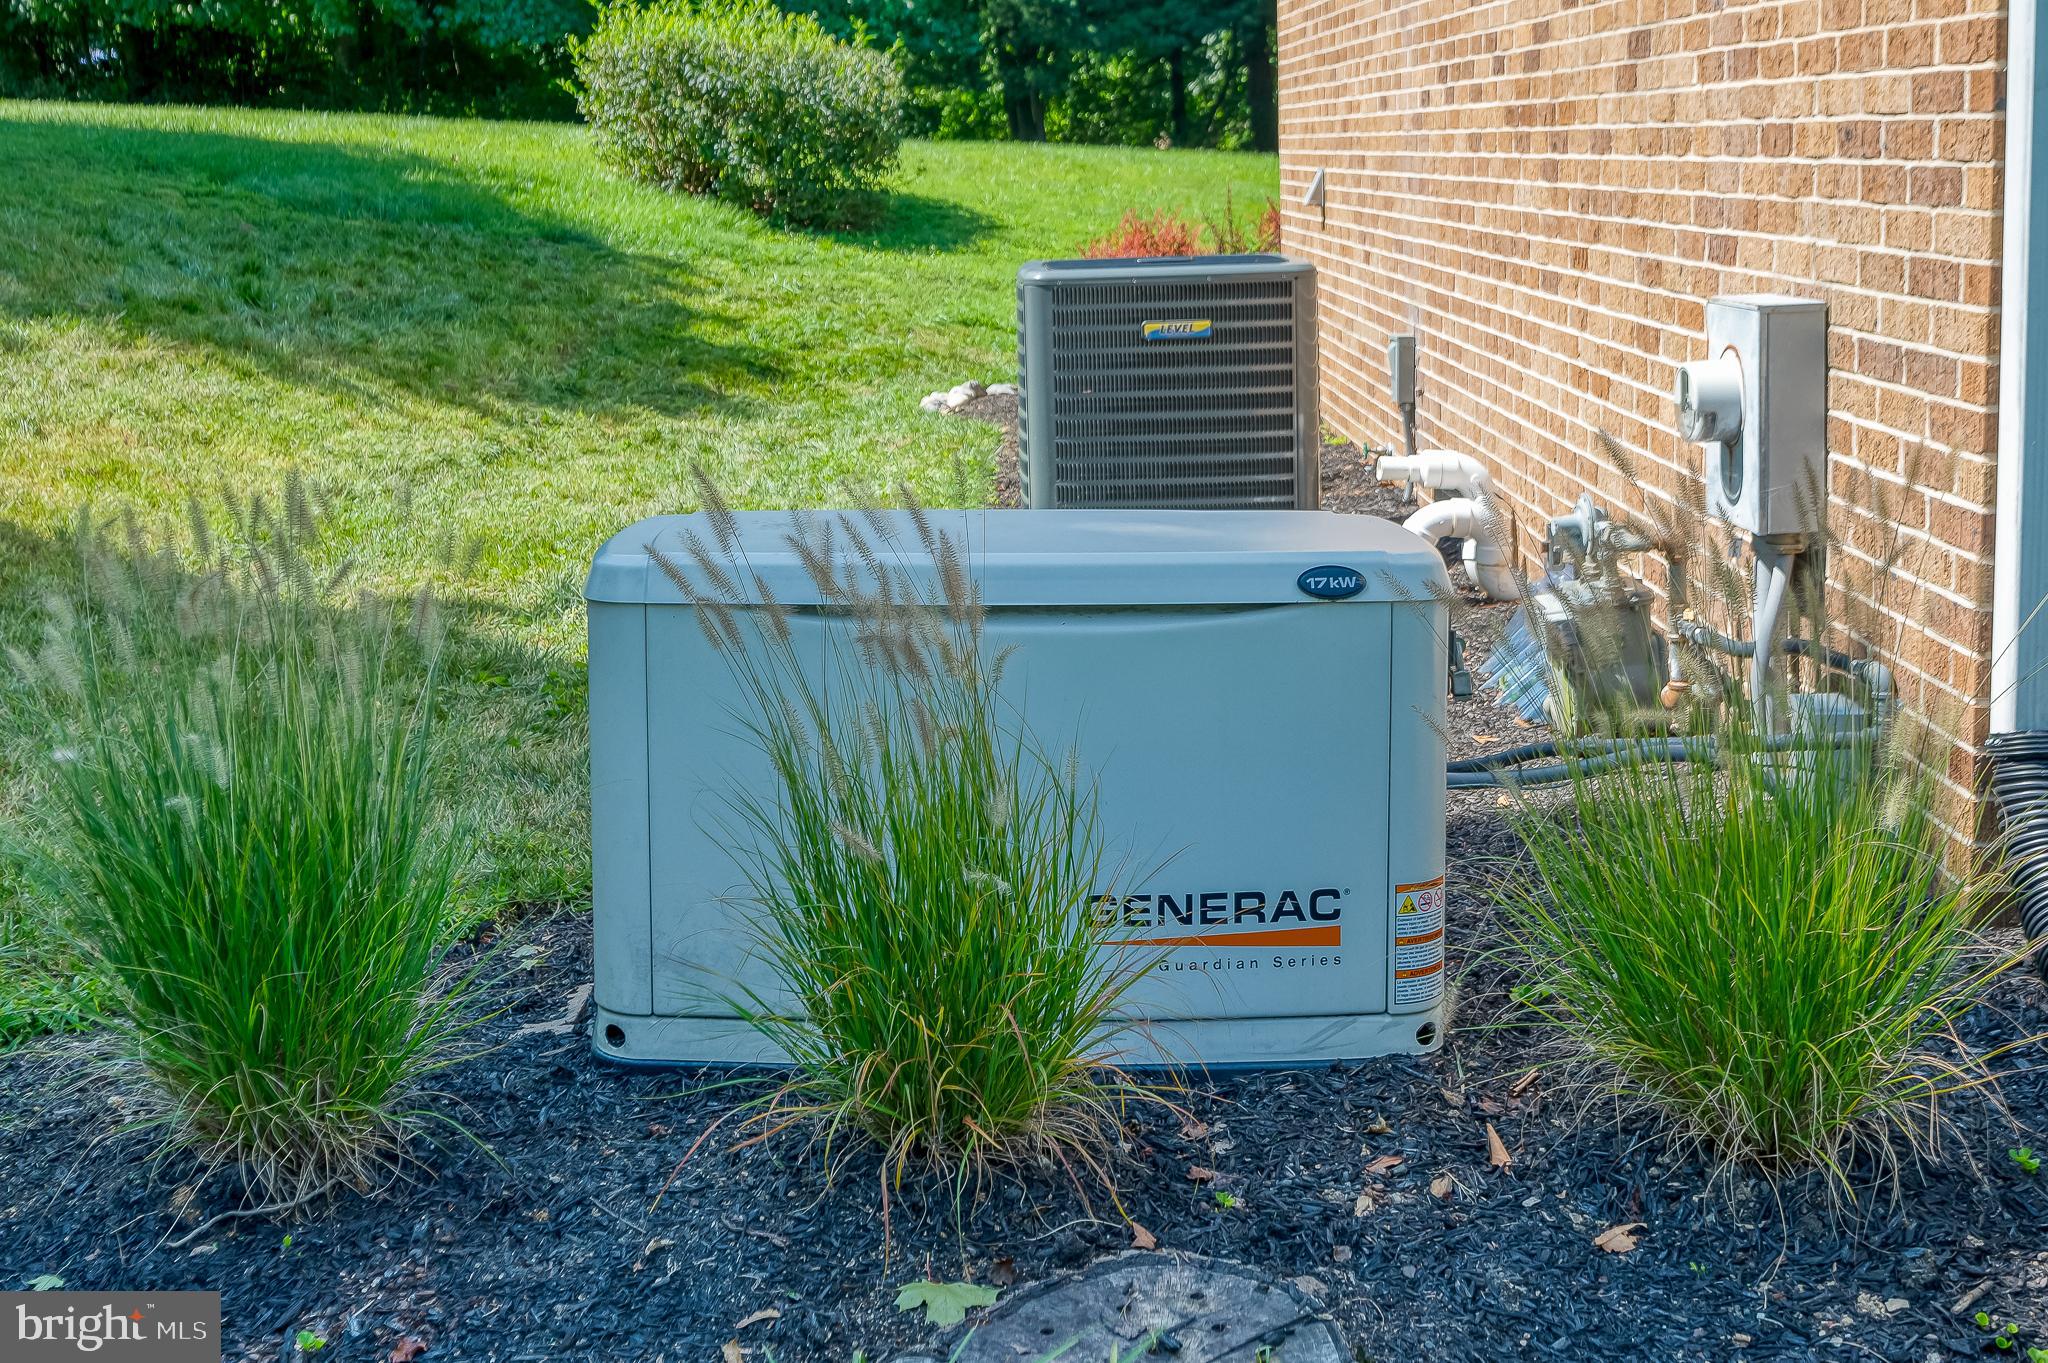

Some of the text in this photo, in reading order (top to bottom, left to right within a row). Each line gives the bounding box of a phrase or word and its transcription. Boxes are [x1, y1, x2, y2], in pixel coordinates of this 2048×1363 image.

[1160, 323, 1194, 335] LEVEL
[1088, 888, 1342, 928] GENERAC
[1158, 954, 1342, 972] Guardian Series
